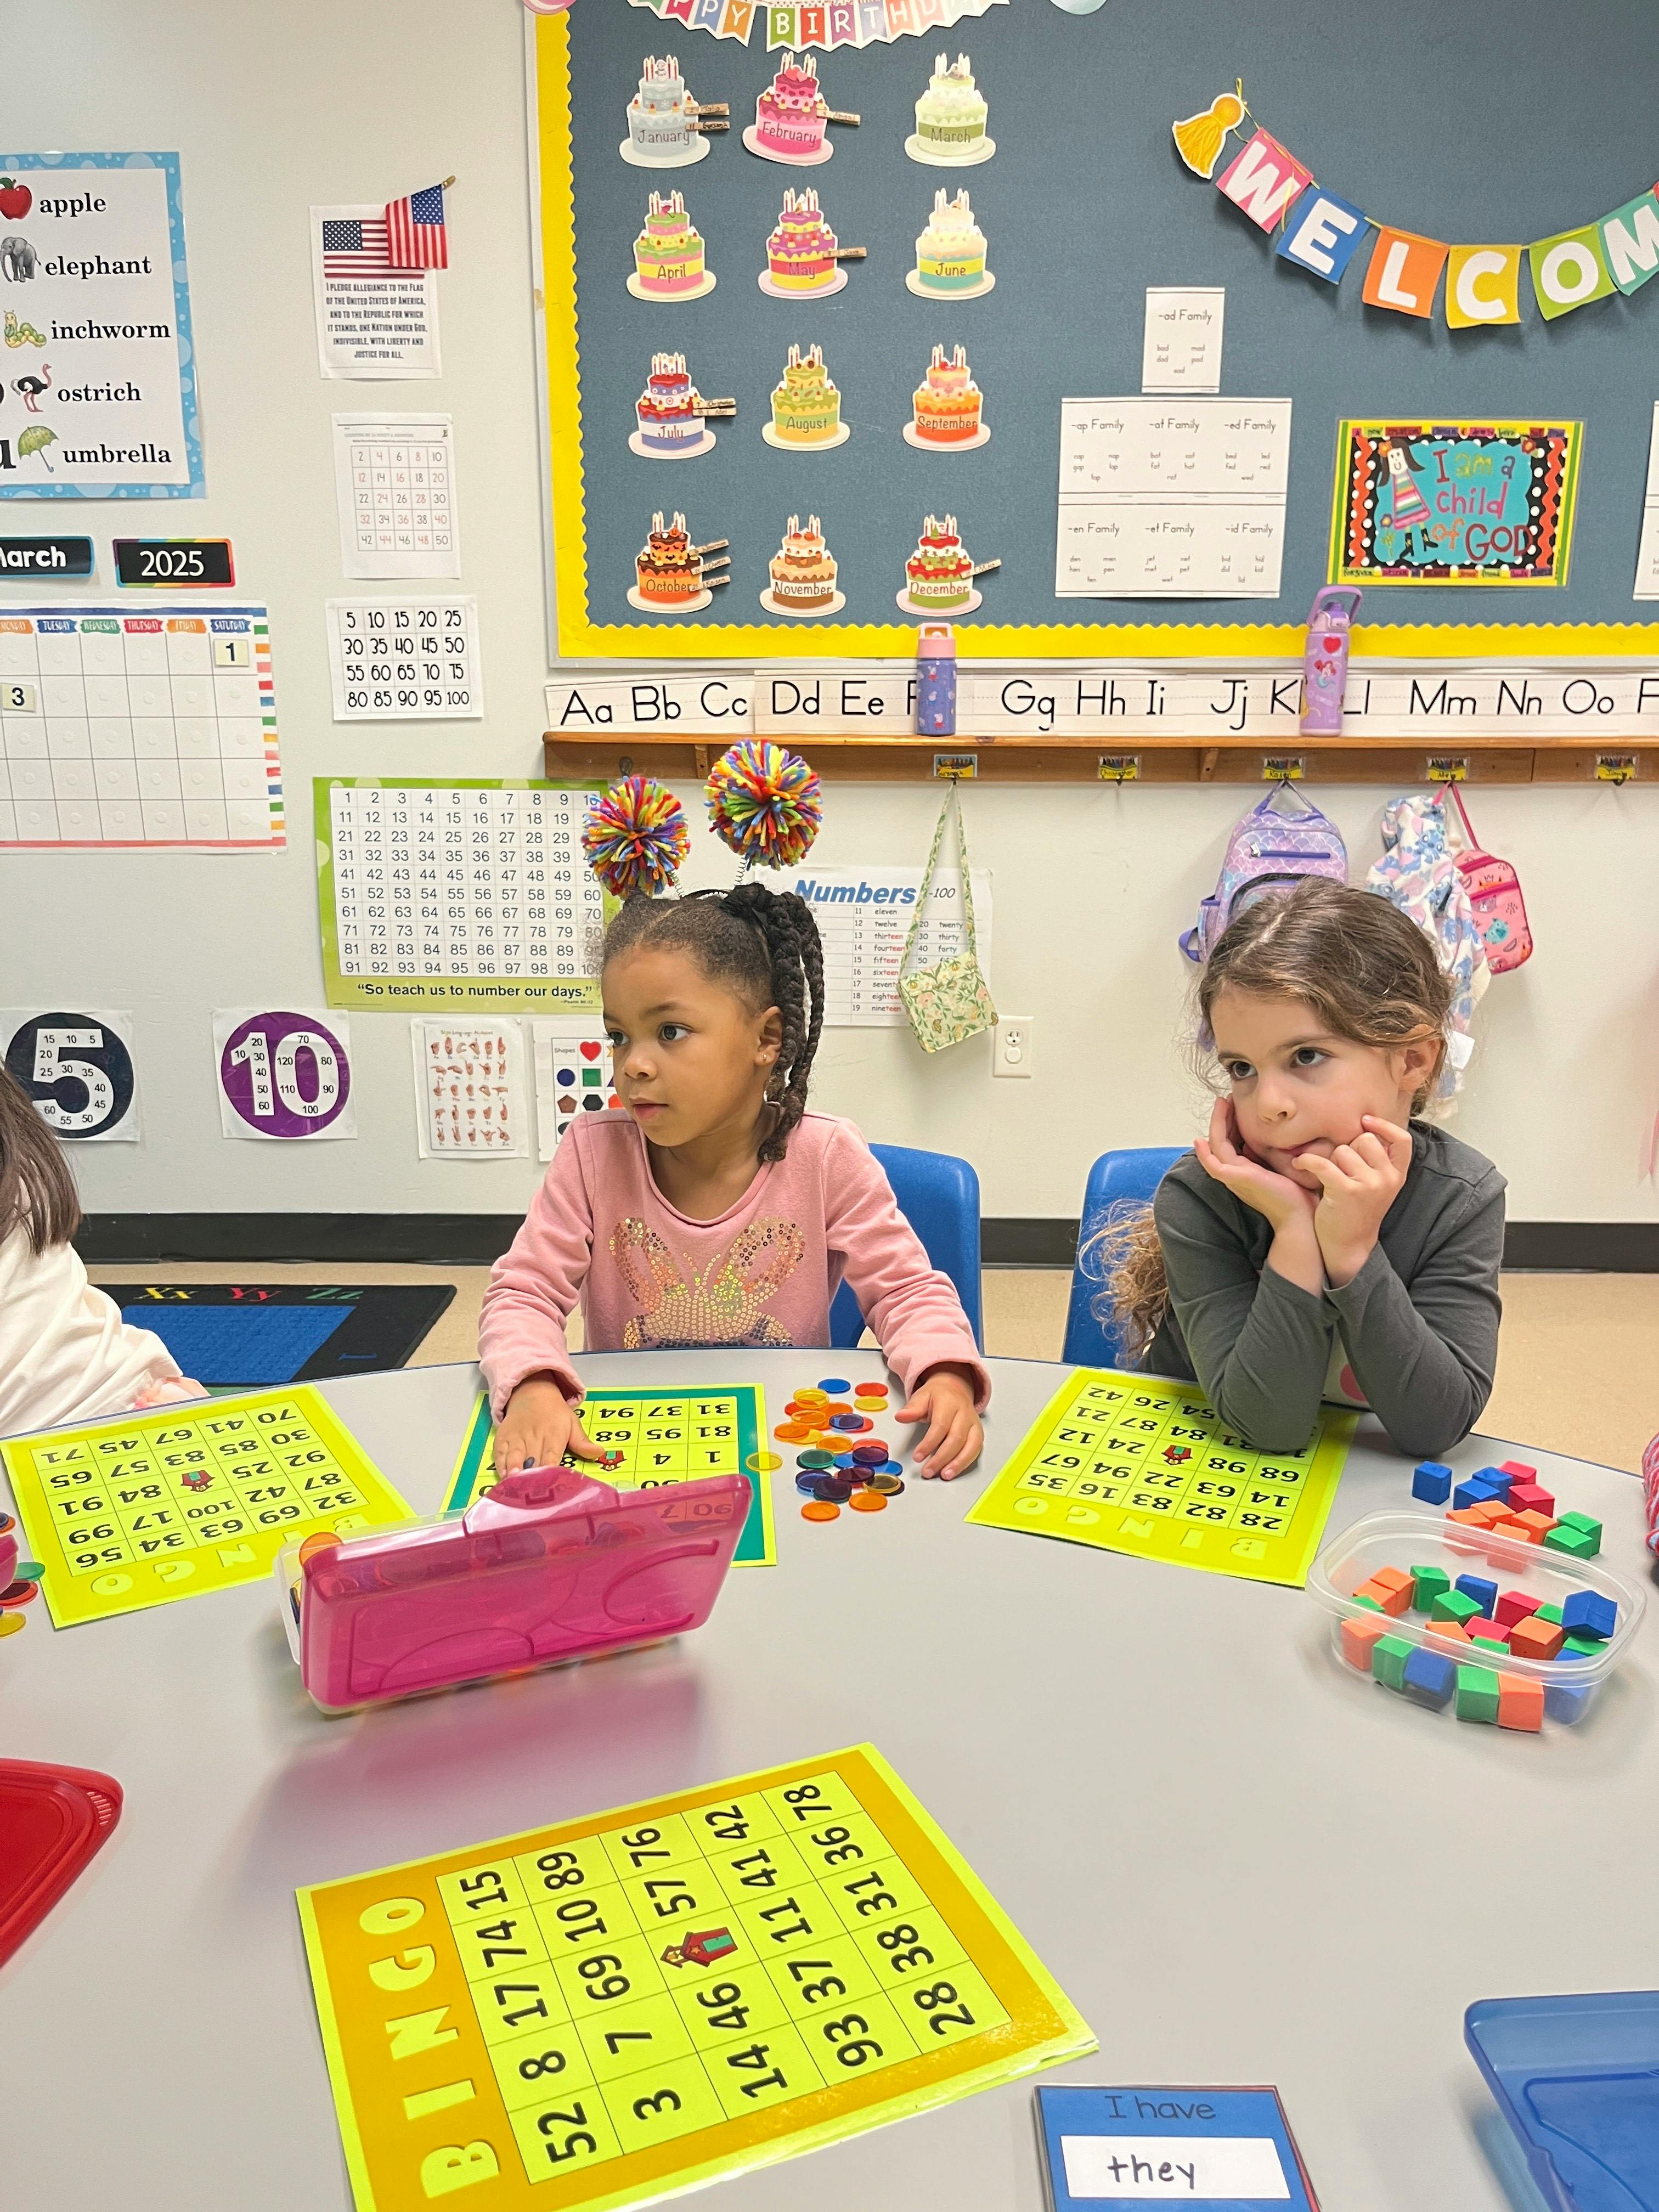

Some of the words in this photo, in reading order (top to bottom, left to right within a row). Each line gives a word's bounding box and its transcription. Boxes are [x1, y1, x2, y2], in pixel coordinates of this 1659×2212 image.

[637, 128, 690, 146] January
[763, 122, 817, 146] February
[932, 127, 970, 144] March
[40, 193, 106, 217] apple
[46, 256, 151, 279] elephant
[658, 263, 686, 283] April
[789, 263, 816, 279] May
[935, 263, 966, 276] June
[1180, 309, 1212, 325] Family
[51, 320, 171, 339] inchworm
[58, 382, 142, 402] ostrich
[786, 416, 827, 433] August
[917, 416, 977, 432] September
[1092, 419, 1124, 433] Family
[1168, 418, 1199, 433] Family
[1244, 419, 1276, 433] Family
[659, 425, 684, 441] July
[63, 444, 172, 462] umbrella
[359, 452, 363, 461] 2
[377, 452, 382, 461] 4
[397, 452, 402, 461] 6
[416, 452, 421, 461] 8
[432, 452, 442, 461] 10
[1432, 449, 1449, 483] I
[1454, 454, 1492, 477] am
[1501, 456, 1515, 478] a
[1436, 481, 1508, 520] child
[1088, 523, 1119, 537] Family
[1146, 523, 1159, 532] -et
[1163, 522, 1194, 537] Family
[1226, 523, 1239, 533] -id
[1242, 523, 1273, 538] Family
[1432, 517, 1464, 550] of
[1465, 524, 1533, 561] GOD
[140, 550, 204, 577] 2025
[646, 579, 692, 594] October
[774, 582, 833, 596] November
[910, 582, 969, 595] December
[43, 622, 70, 630] TUESDAY
[83, 622, 117, 630] WEDNESDAY
[128, 622, 158, 630] THURSDAY
[176, 622, 196, 630] FRIDAY
[215, 621, 245, 630] SATURDAY
[347, 612, 356, 628] 5
[368, 612, 385, 628] 10
[394, 611, 409, 628] 15
[419, 611, 437, 627] 20
[445, 611, 461, 627] 25
[225, 642, 235, 662] 1
[12, 687, 25, 706] 3
[561, 690, 612, 725] Aa
[632, 685, 681, 721] Bb
[701, 682, 747, 717] Cc
[772, 680, 819, 714] Dd
[842, 681, 884, 715] Ee
[1002, 680, 1054, 731] Gg
[1077, 680, 1125, 715] Hh
[1147, 680, 1165, 715] Ii
[1211, 680, 1248, 730] Jj
[1410, 680, 1476, 715] Mm
[1497, 680, 1542, 715] Nn
[1563, 680, 1613, 714] Oo
[346, 792, 350, 803] 1
[371, 792, 379, 803] 2
[398, 793, 406, 804] 3
[425, 793, 432, 804] 4
[453, 793, 460, 804] 5
[479, 793, 487, 804] 6
[506, 794, 513, 804] 7
[533, 794, 541, 805] 8
[560, 794, 568, 805] 9
[794, 880, 917, 904] Numbers
[939, 921, 963, 930] twenty
[388, 985, 425, 995] teach
[450, 985, 463, 995] to
[469, 985, 520, 996] number
[44, 1035, 55, 1043] 15
[66, 1035, 77, 1043] 10
[33, 1028, 114, 1130] 5
[231, 1031, 340, 1117] 10
[134, 1288, 198, 1300] Xx
[229, 1288, 282, 1302] Yy
[306, 1288, 364, 1300] Zz
[1028, 1474, 1068, 1491] 35
[1079, 1483, 1119, 1500] 16
[1131, 1493, 1173, 1510] 83
[1184, 1502, 1227, 1520] 82
[1240, 1513, 1283, 1530] 28
[460, 1870, 509, 1910] 15
[476, 1919, 527, 1968] 74
[494, 1984, 549, 2027] 17
[359, 1897, 500, 2198] BINGO
[518, 2050, 566, 2080] 8
[1105, 2095, 1126, 2119] I
[1135, 2095, 1216, 2120] have
[537, 2101, 597, 2164] 52
[1107, 2154, 1195, 2190] they
